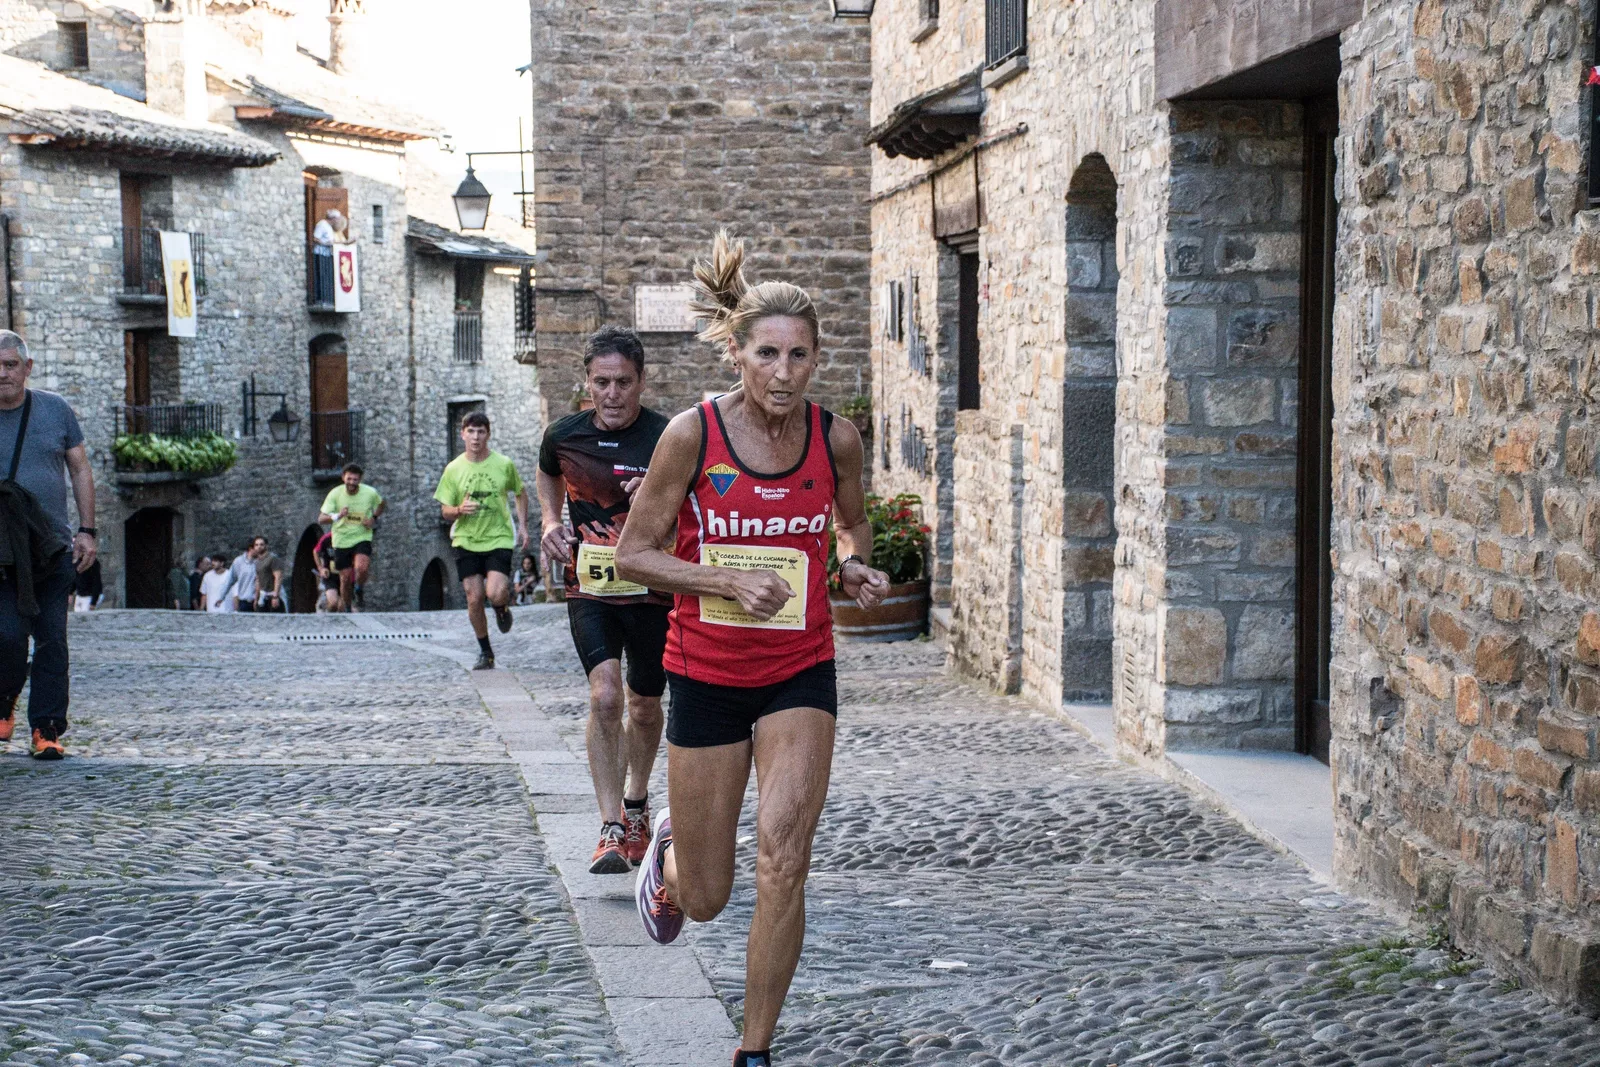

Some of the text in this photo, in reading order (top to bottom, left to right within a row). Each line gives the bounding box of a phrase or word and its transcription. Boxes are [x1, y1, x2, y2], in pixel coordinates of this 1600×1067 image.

[707, 508, 826, 538] hinaco
[589, 564, 617, 582] 51
[749, 562, 784, 570] SEPTIEMBRE
